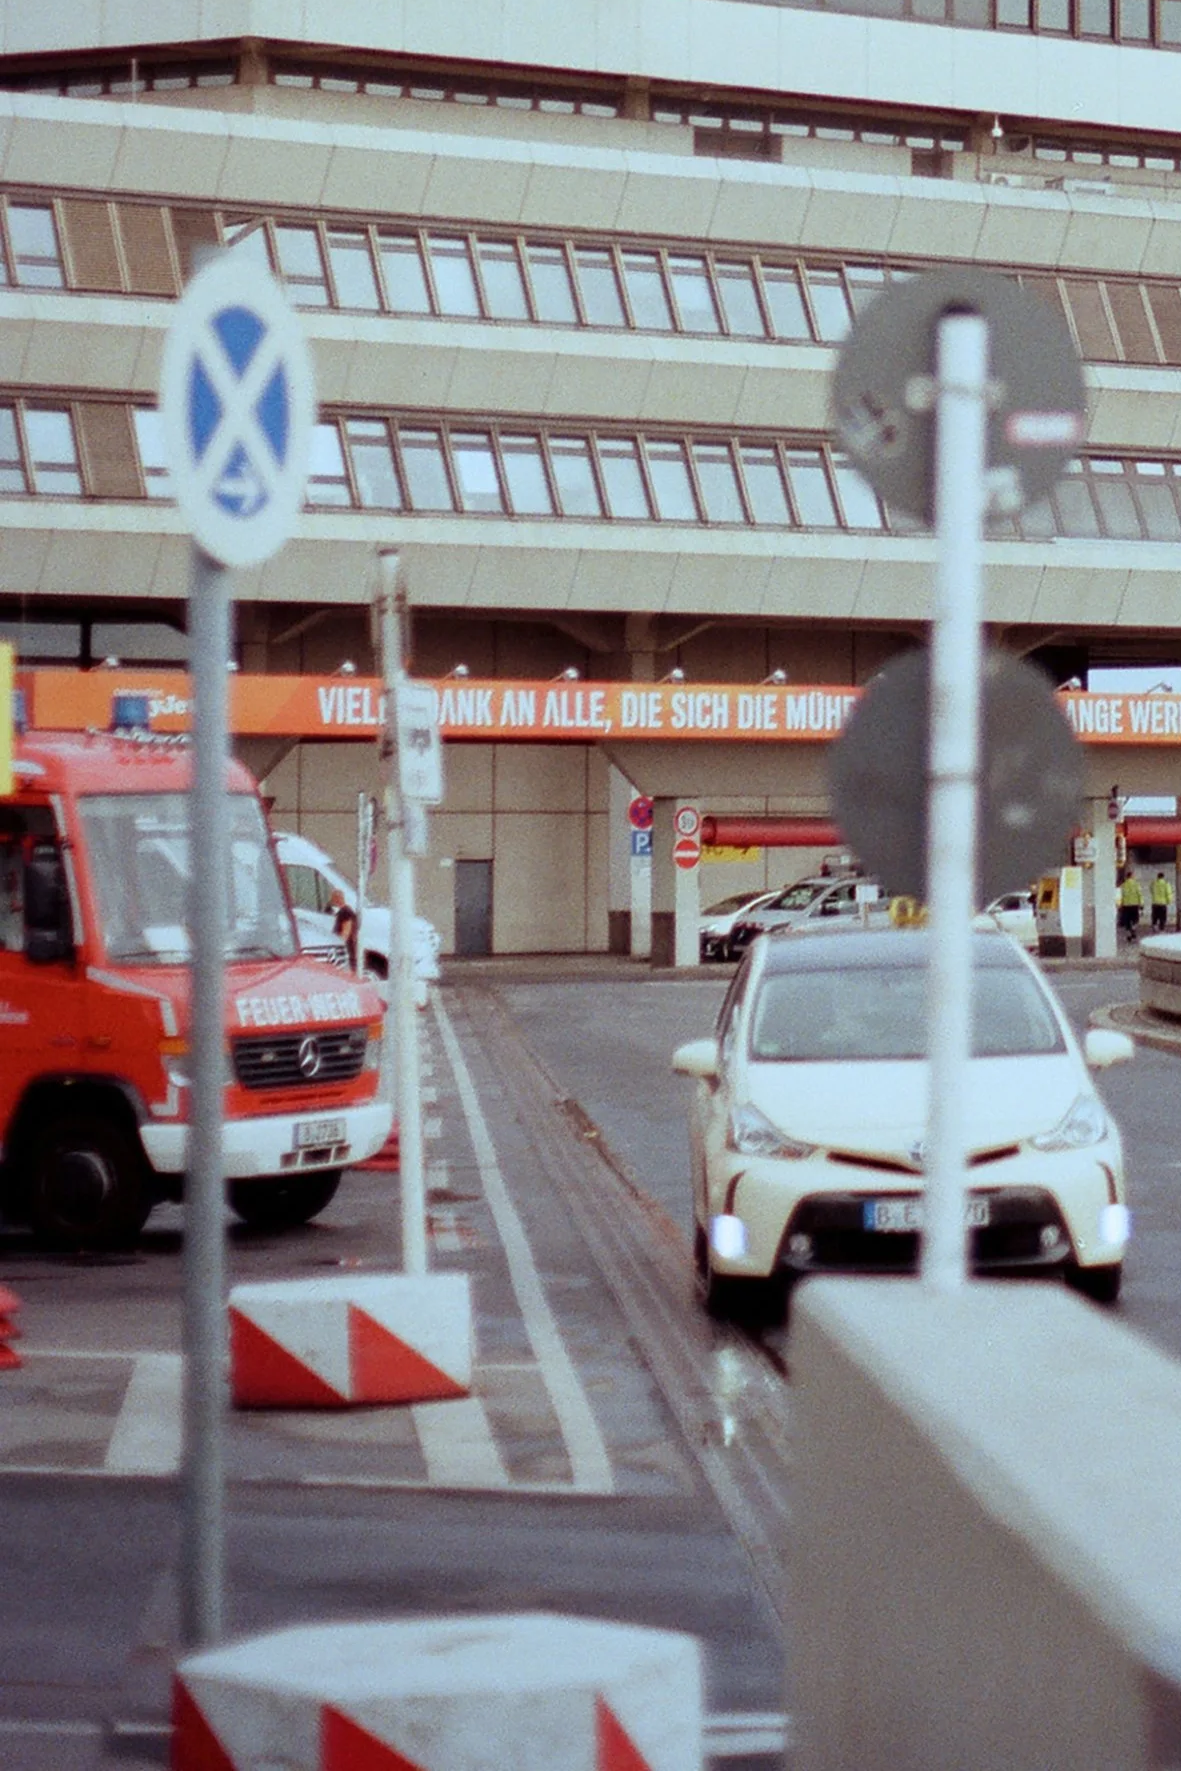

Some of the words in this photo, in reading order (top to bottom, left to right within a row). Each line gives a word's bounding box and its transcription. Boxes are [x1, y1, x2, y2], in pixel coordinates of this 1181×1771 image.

[436, 688, 493, 727] ANK
[500, 689, 536, 726] AN
[543, 690, 613, 733] ALLE,
[621, 691, 663, 729] DIE
[671, 692, 729, 730] SICH
[738, 694, 778, 730] DIE
